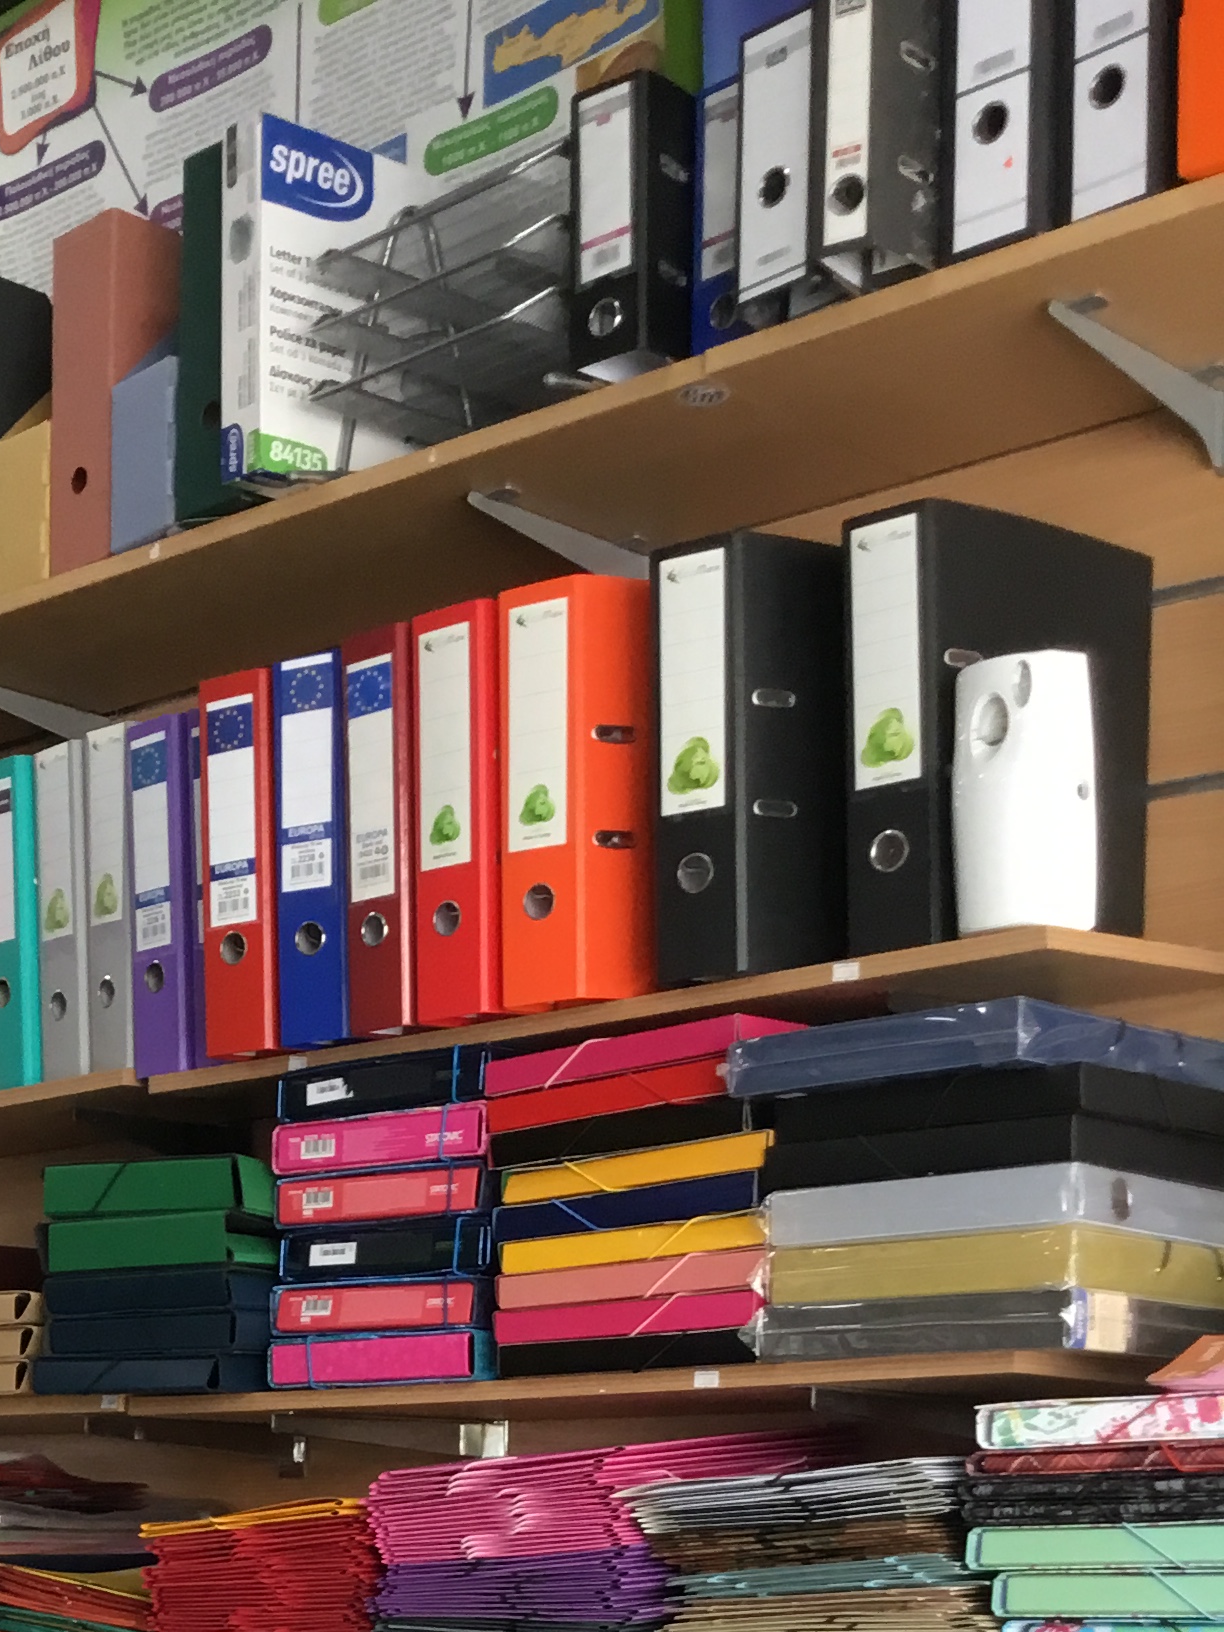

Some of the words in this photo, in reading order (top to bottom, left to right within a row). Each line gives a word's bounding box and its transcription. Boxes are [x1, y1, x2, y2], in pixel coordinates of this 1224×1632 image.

[4, 27, 51, 60] Εποχή
[28, 40, 71, 70] Λίθου
[269, 143, 352, 196] spree
[228, 428, 239, 473] spree
[269, 440, 323, 471] 84135
[287, 824, 325, 839] EUROPA
[355, 828, 388, 844] EUROPA
[214, 859, 249, 875] EUROPA
